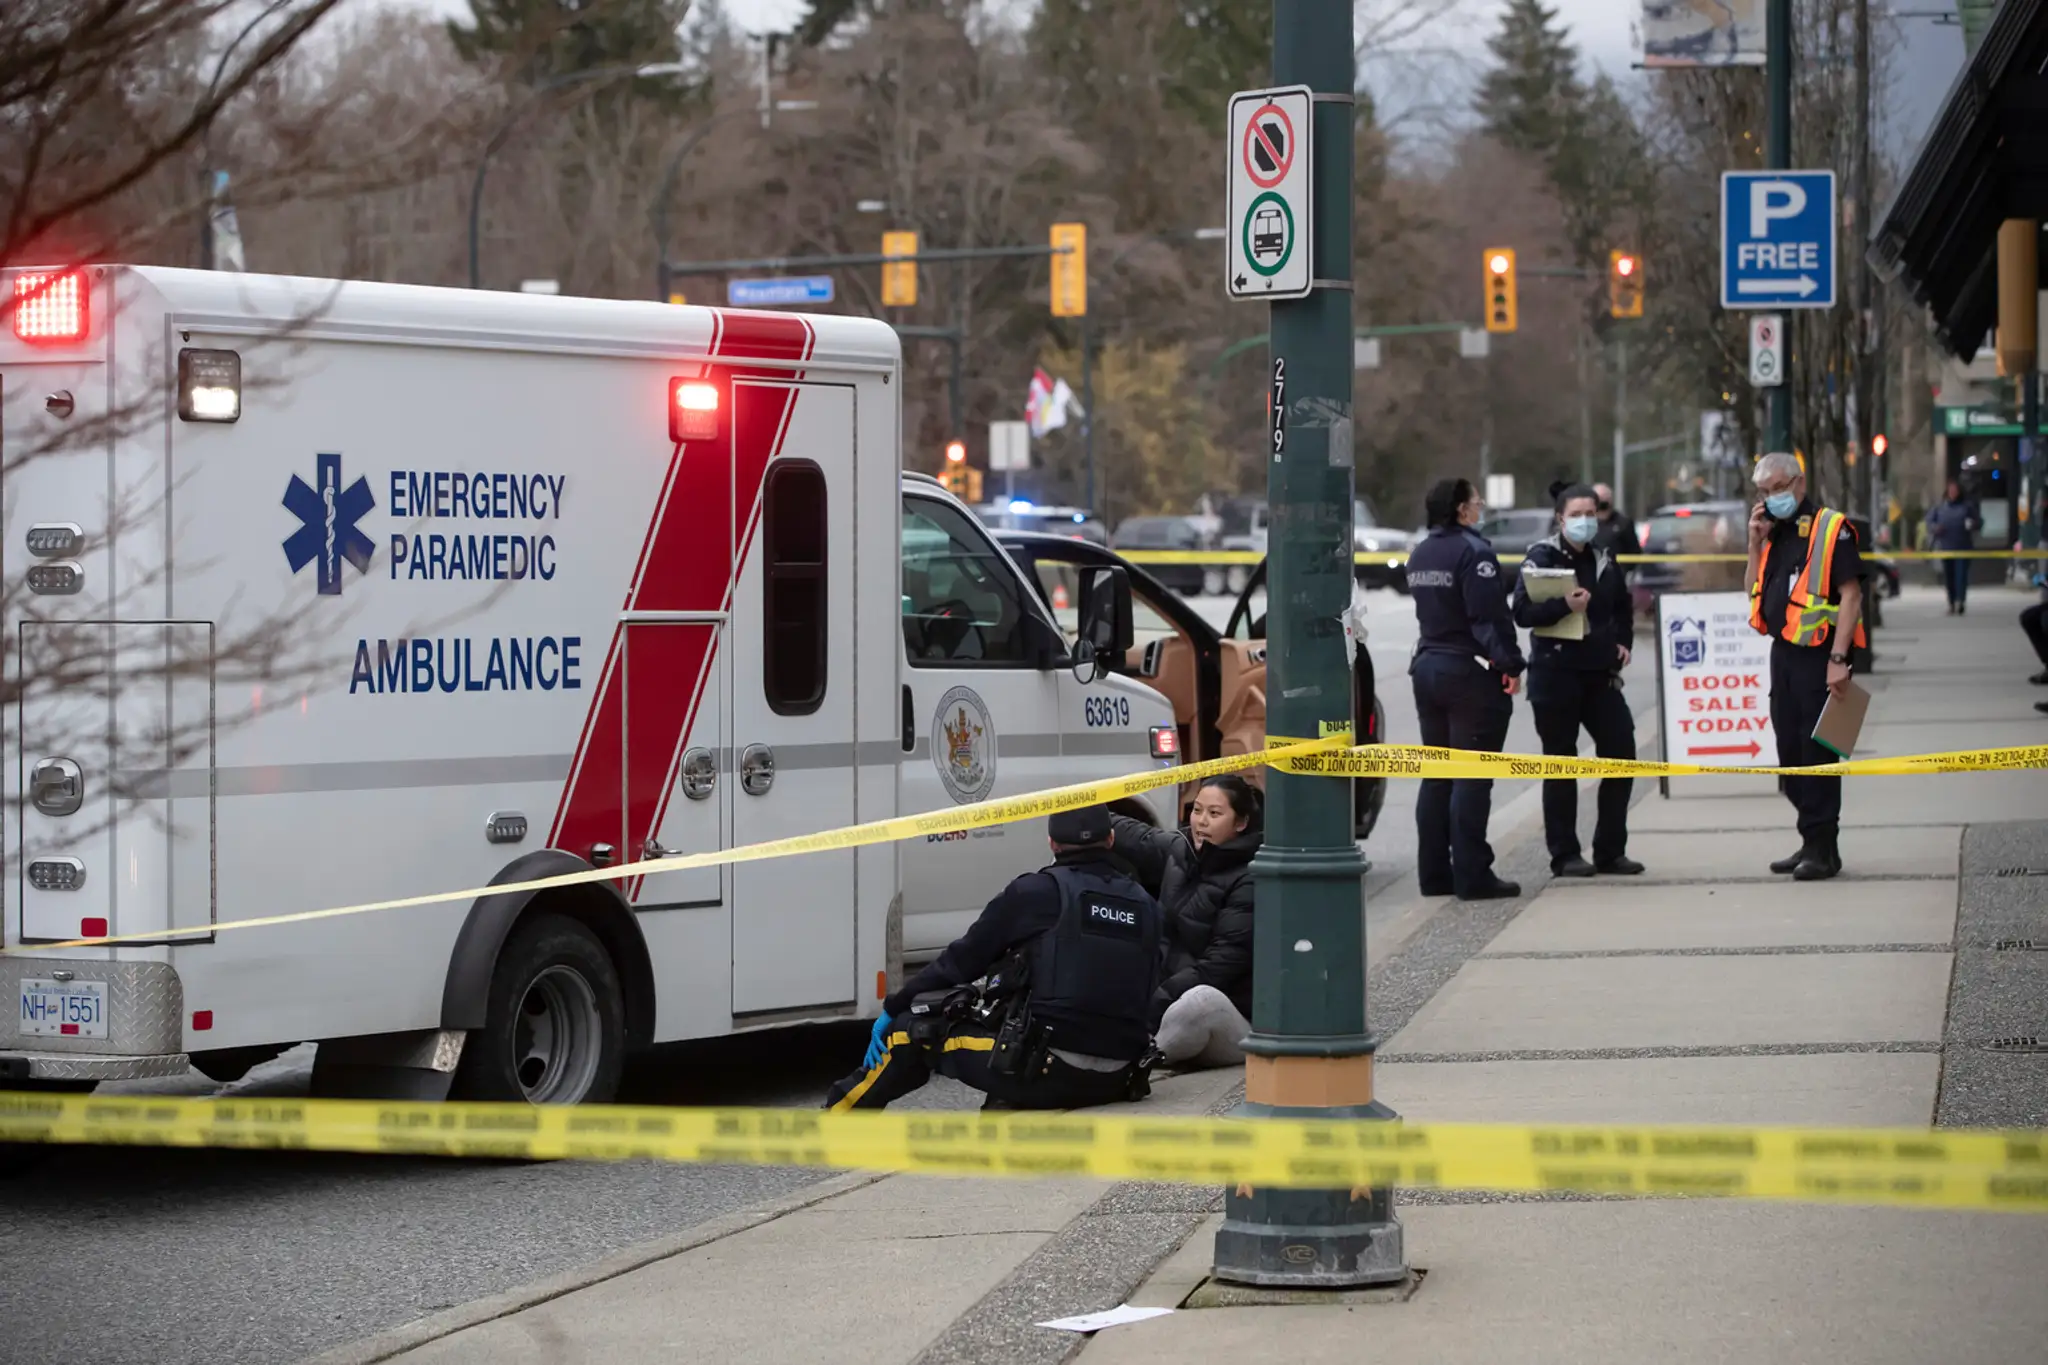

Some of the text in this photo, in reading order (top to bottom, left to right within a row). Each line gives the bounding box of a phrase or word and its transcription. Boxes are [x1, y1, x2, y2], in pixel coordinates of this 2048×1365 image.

[1750, 181, 1807, 238] P
[1738, 242, 1819, 269] FREE
[1274, 357, 1285, 452] 2779
[391, 471, 565, 519] EMERGENCY
[391, 534, 556, 581] PARAMEDIC
[349, 636, 581, 694] AMBULANCE
[1682, 674, 1760, 690] BOOK
[1086, 696, 1129, 727] 63619
[1689, 696, 1757, 712] SALE
[1678, 716, 1769, 733] TODAY
[1291, 757, 1421, 773] POLICE LINE DO NOT CROSS
[1511, 762, 1542, 775] CROSS
[1544, 763, 1563, 775] NOT
[1091, 905, 1135, 925] POLICE
[22, 994, 100, 1023] NH 1551
